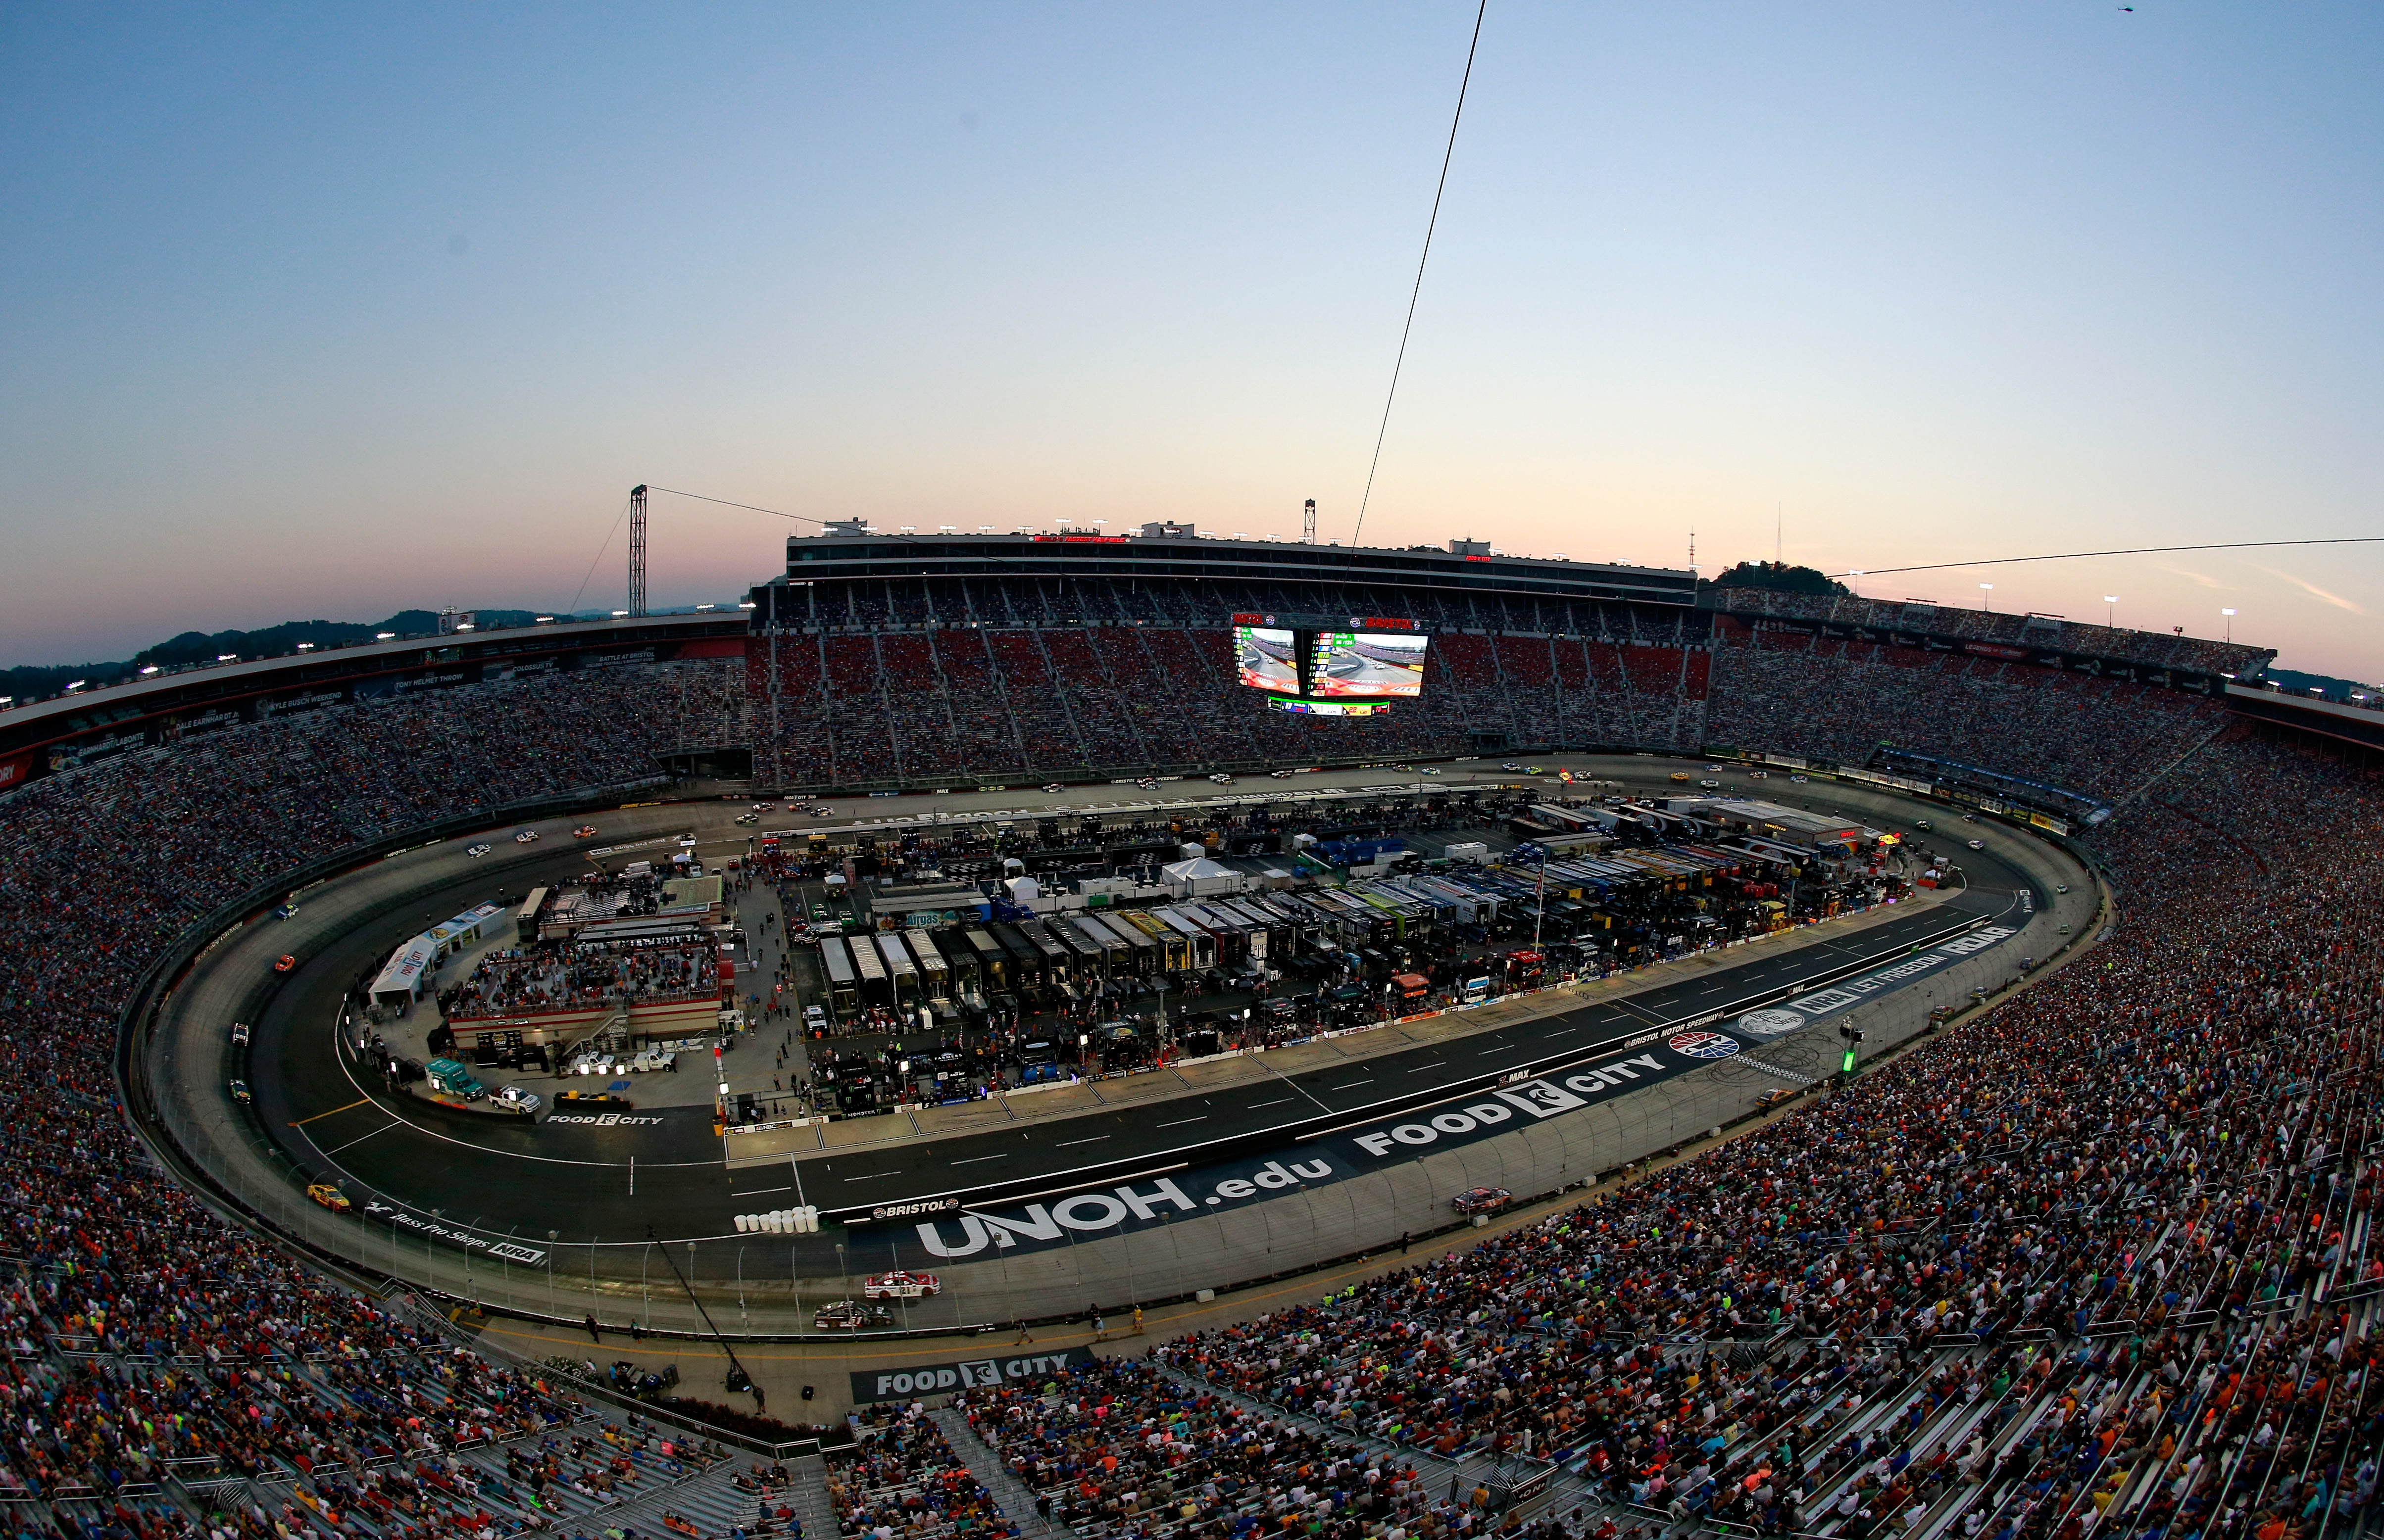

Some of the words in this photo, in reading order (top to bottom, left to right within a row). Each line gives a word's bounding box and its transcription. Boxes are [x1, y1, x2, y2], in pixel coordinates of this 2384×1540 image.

[1365, 617, 1412, 629] BRISTOL
[396, 680, 412, 688] TONY
[413, 677, 438, 686] HELMET
[440, 673, 464, 682] THROW
[288, 698, 309, 707] BUSCH
[310, 692, 342, 703] WEEKEND
[176, 718, 192, 731] DALE
[79, 731, 145, 755] EARNHARDT/LABONTE
[1889, 786, 1913, 796] COLOSSEUM
[1764, 823, 1787, 831] GOODYEAR
[387, 848, 406, 858] MONSTER
[907, 914, 938, 925] Airgas
[1938, 926, 2017, 956] ROAR
[400, 964, 414, 976] FOOD
[410, 951, 423, 961] CITY
[1845, 977, 1885, 993] LET
[1874, 954, 1947, 982] FREEDOM
[1797, 991, 1850, 1012] NRA
[1749, 1011, 1775, 1019] Bass
[1773, 1016, 1802, 1026] Shops
[606, 1025, 627, 1035] Smoky
[1630, 1032, 1658, 1047] BRISTOL
[1661, 1023, 1684, 1037] MOTOR
[1686, 1013, 1719, 1030] SPEEDWAY
[1352, 1103, 1511, 1156] FOOD
[1565, 1053, 1666, 1093] CITY
[619, 1116, 664, 1125] CITY
[886, 1201, 946, 1217] BRISTOL
[916, 1158, 1333, 1258] UNOH.edu
[390, 1213, 426, 1227] Bass
[422, 1225, 449, 1235] Pro
[447, 1231, 491, 1248] Shops
[495, 1244, 537, 1260] NRA
[877, 1369, 956, 1395] FOOD
[1005, 1353, 1068, 1378] CITY
